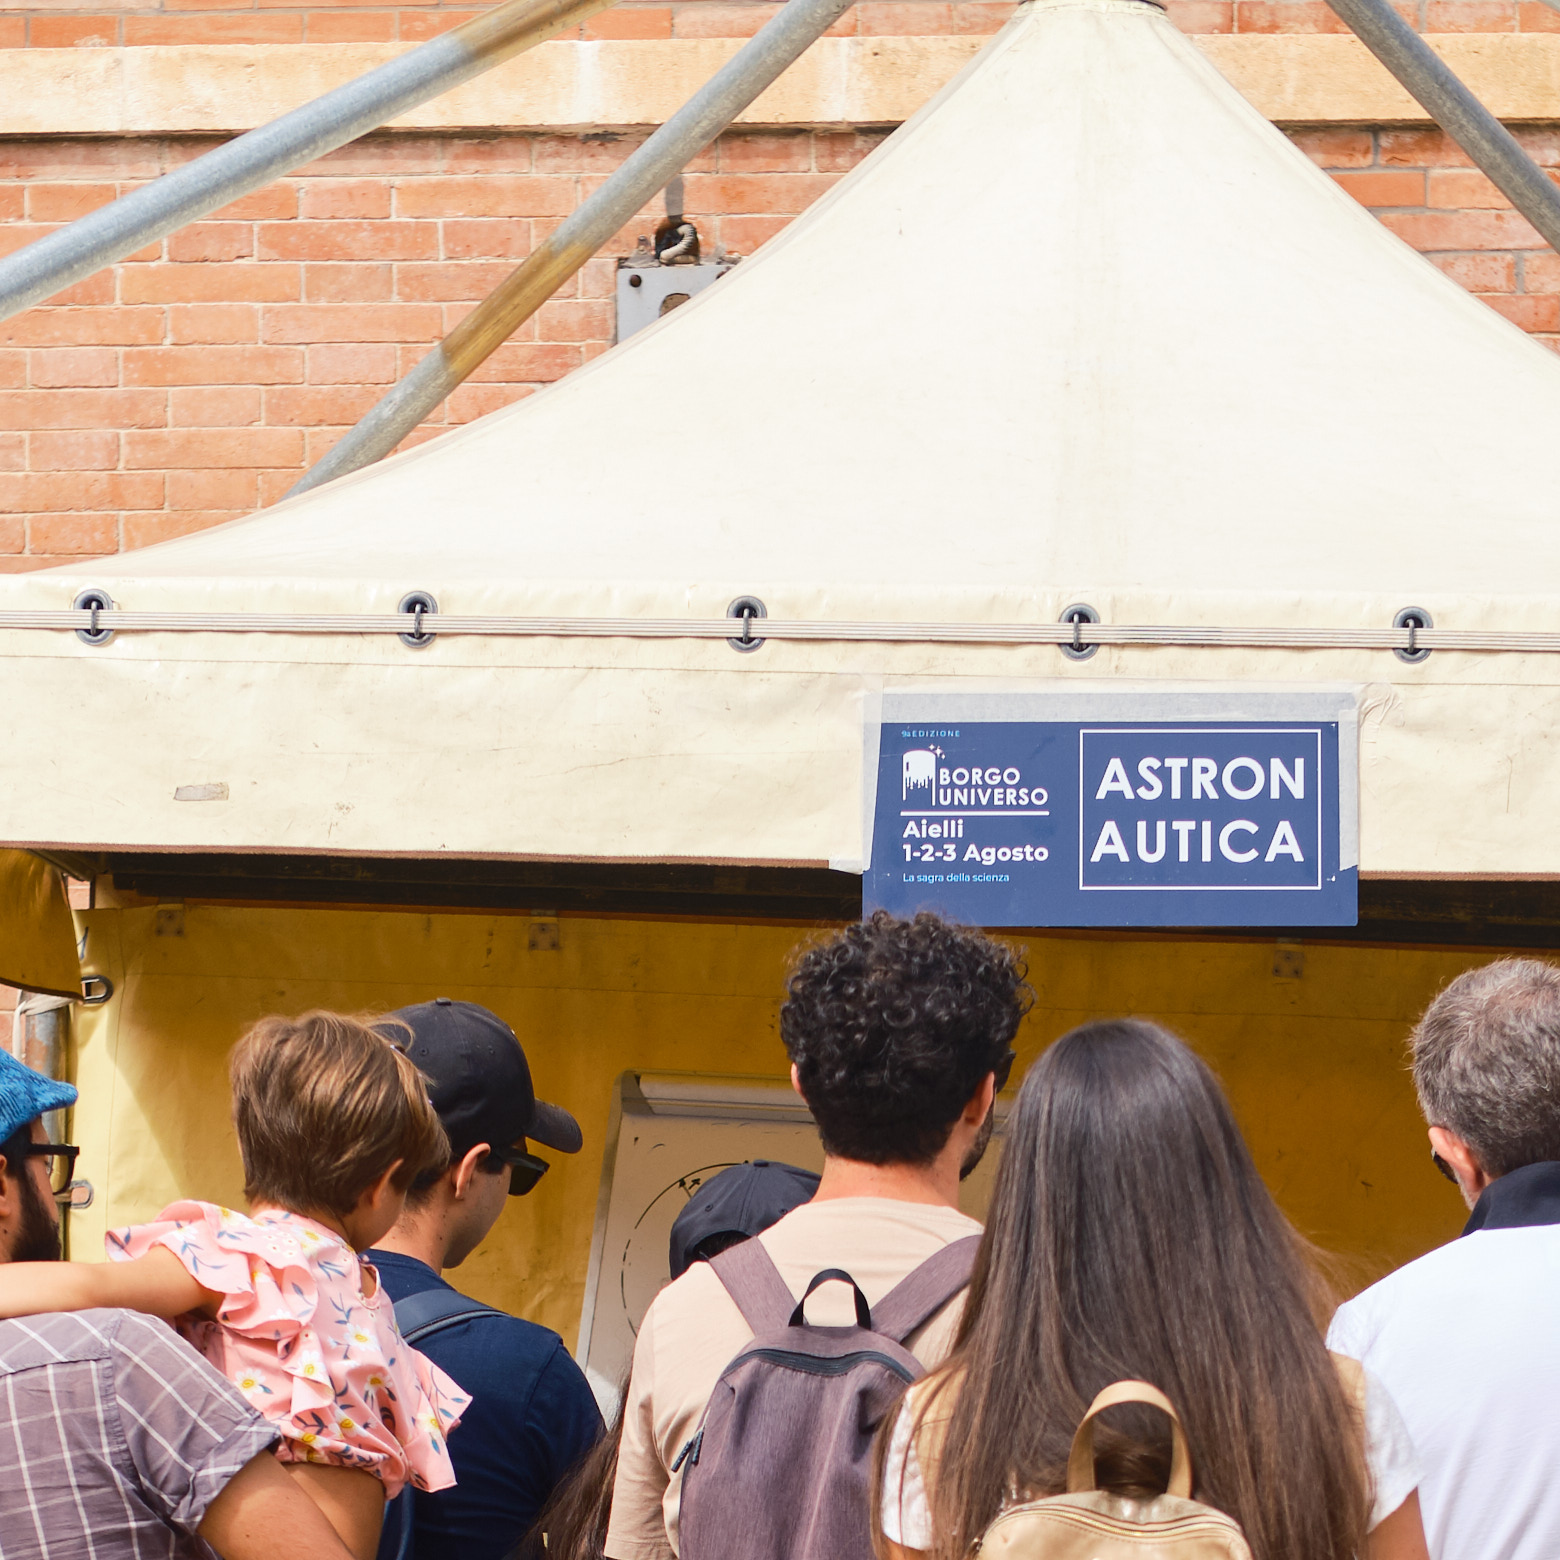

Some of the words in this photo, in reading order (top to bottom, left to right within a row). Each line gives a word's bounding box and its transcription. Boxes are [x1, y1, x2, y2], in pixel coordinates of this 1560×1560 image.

[940, 767, 1020, 785] BORGO
[1095, 756, 1305, 800] ASTRON
[940, 787, 1048, 806] UNIVERSO
[902, 818, 963, 838] Aielli
[1090, 819, 1304, 863] AUTICA
[902, 843, 957, 862] 1-2-3
[962, 843, 1049, 866] Agosto
[903, 873, 914, 882] La
[916, 875, 944, 884] sagra
[946, 873, 970, 882] della
[972, 873, 1010, 882] scienza
